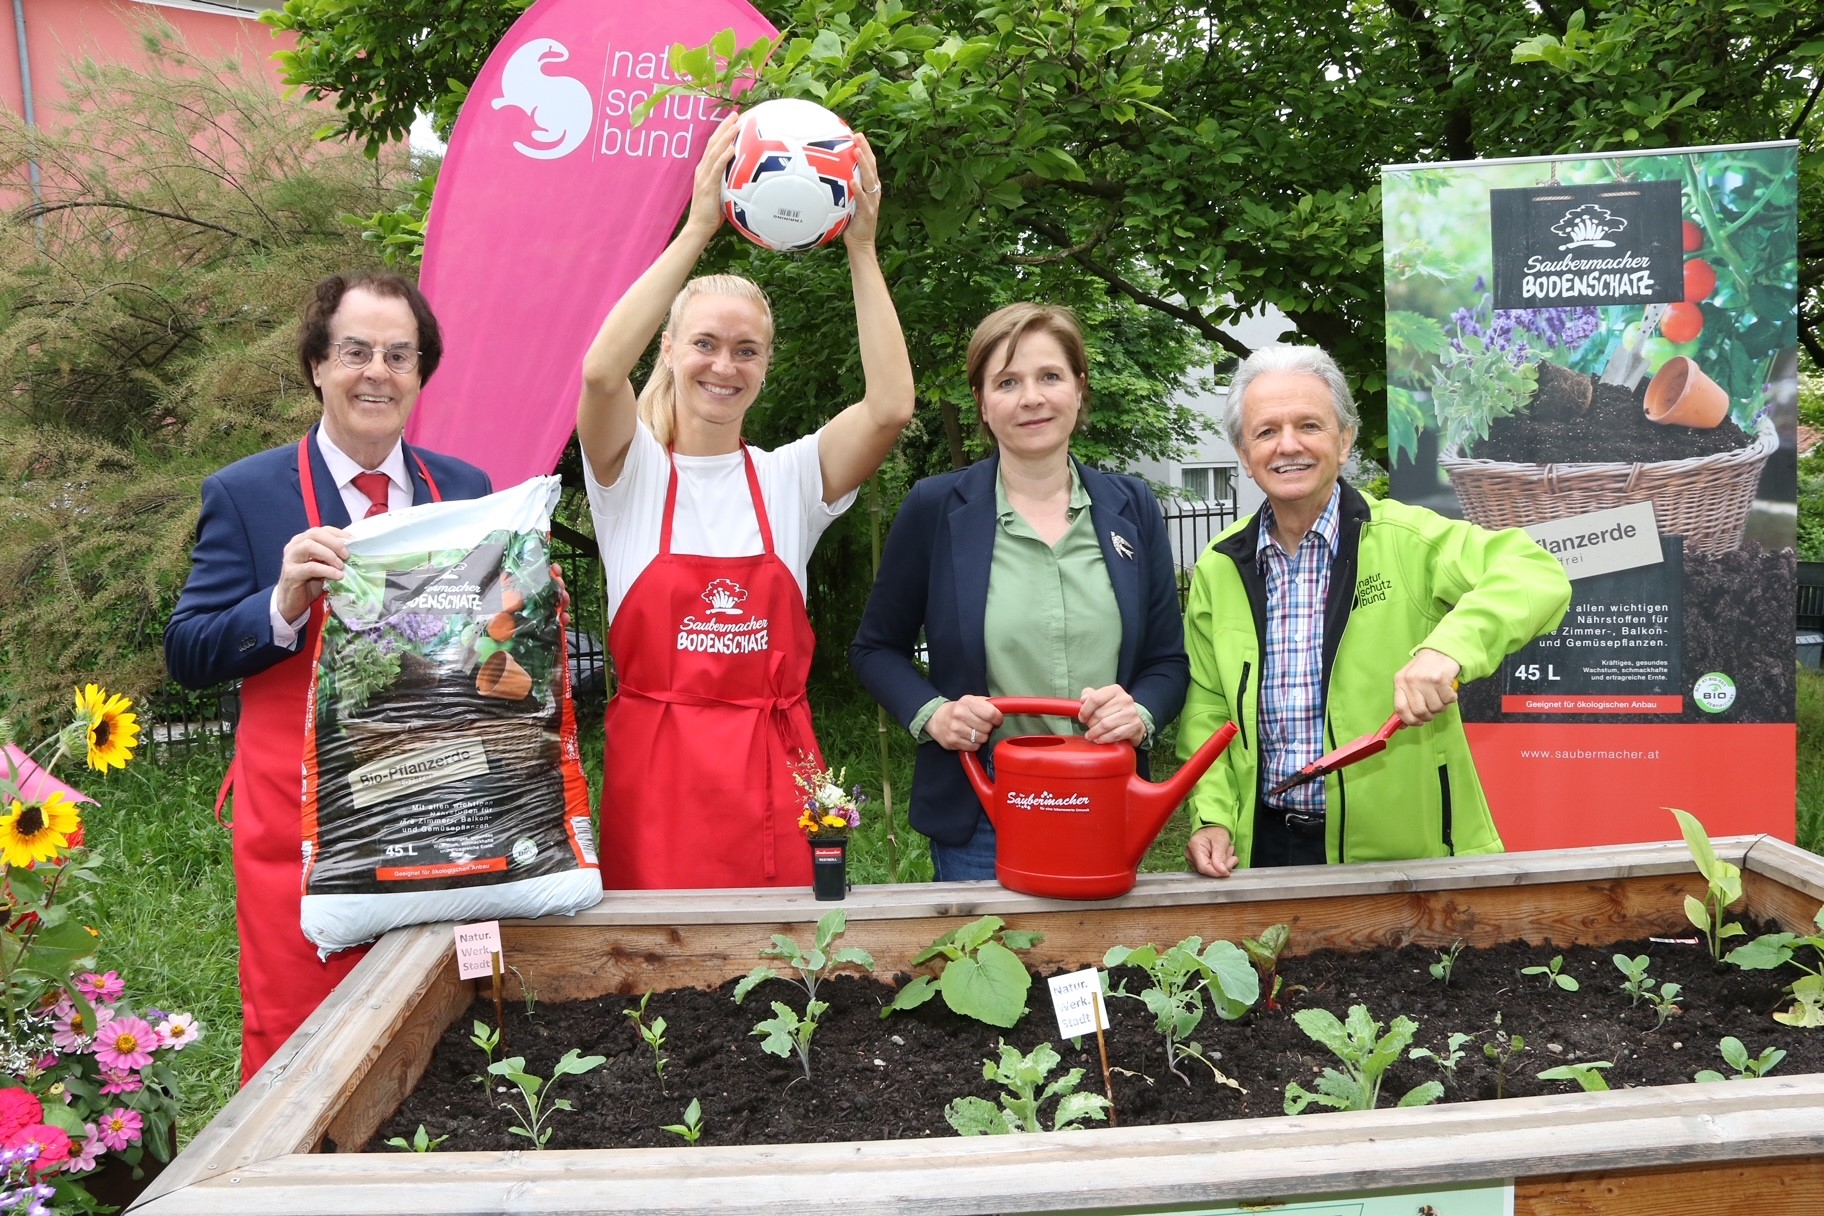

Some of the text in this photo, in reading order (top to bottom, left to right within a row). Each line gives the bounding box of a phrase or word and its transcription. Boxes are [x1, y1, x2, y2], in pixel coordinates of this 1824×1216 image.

[601, 119, 694, 159] bund
[1524, 251, 1651, 274] Saubermacher
[1522, 270, 1655, 298] BODENSCHATZ
[1358, 572, 1381, 588] natur
[1360, 580, 1392, 598] schutz
[1361, 590, 1386, 607] bund
[1575, 603, 1605, 612] allen
[1610, 603, 1669, 614] wichtigen
[680, 616, 768, 632] Saubermacher
[1577, 615, 1669, 624] Nährstoffen für
[1562, 626, 1616, 636] Zimmer-,
[1621, 626, 1669, 635] Balkon-
[677, 630, 768, 654] BODENSCHATZ
[1540, 638, 1669, 648] und Gemüsepflanzen.
[1515, 664, 1561, 681] 45 L
[1703, 692, 1727, 700] BIO
[1526, 700, 1657, 709] Geeignet für ökologischen Anbau
[1520, 749, 1660, 760] www.saubermacher.at
[1006, 791, 1090, 806] Saubermacher
[385, 844, 404, 857] 45
[408, 843, 419, 856] L
[432, 866, 470, 875] ökologischen
[460, 932, 492, 943] Natur.
[463, 960, 491, 971] Stadt
[1053, 980, 1088, 996] Natur.
